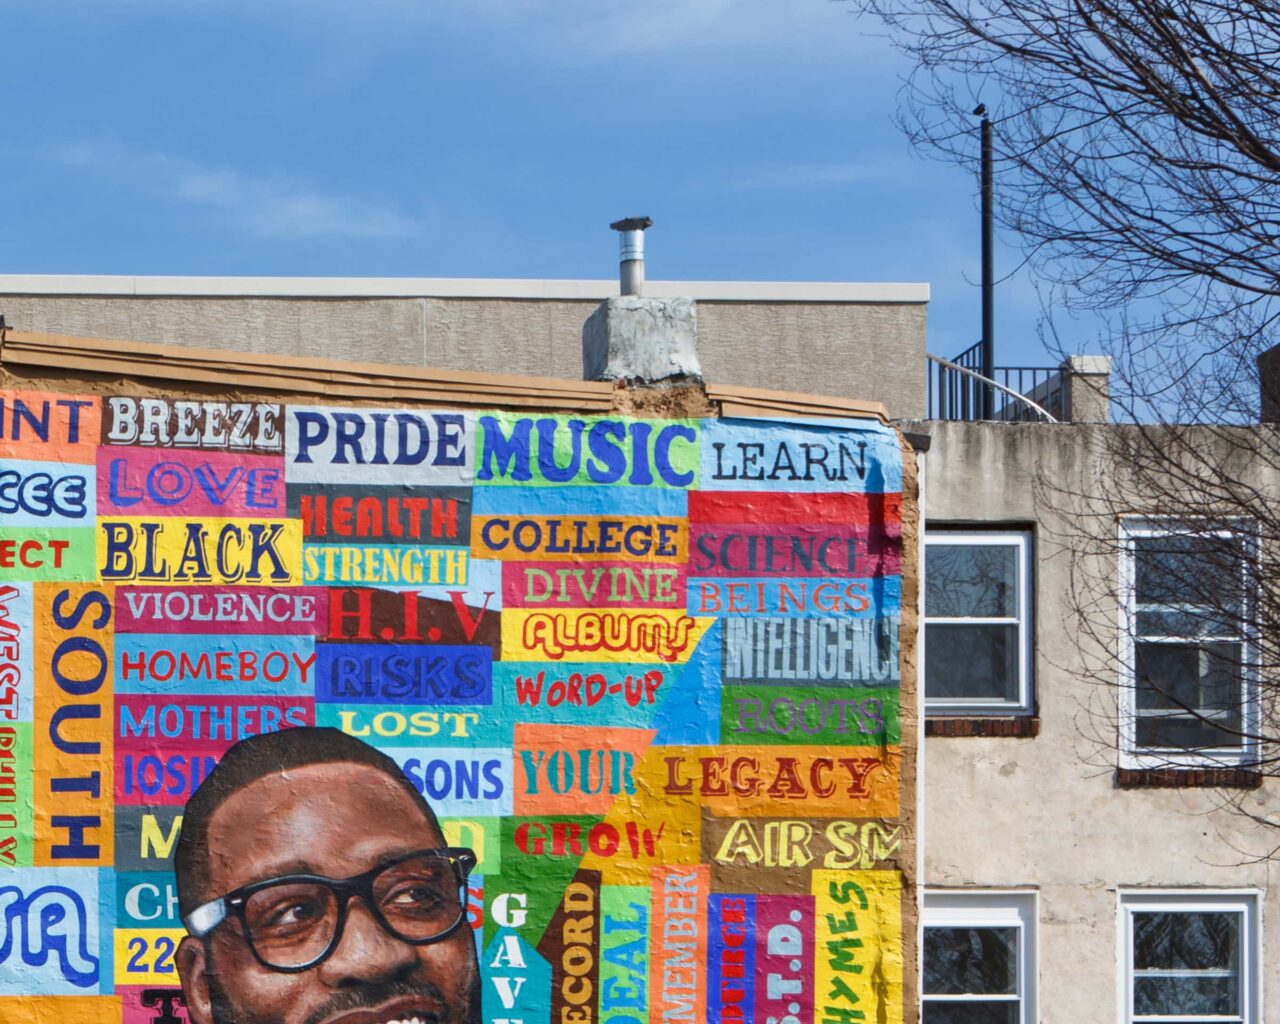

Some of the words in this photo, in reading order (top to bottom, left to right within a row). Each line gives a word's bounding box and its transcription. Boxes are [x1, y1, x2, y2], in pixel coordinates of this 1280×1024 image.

[109, 396, 282, 451] BREEZE
[293, 411, 467, 467] PRIDE
[477, 416, 697, 487] MUSIC
[711, 441, 868, 482] LEARN
[109, 458, 279, 509] LOVE
[300, 494, 458, 539] HEALTH
[481, 518, 678, 557] COLLEGE
[100, 522, 291, 584] BLACK
[302, 547, 468, 586] STRENGTH
[695, 532, 869, 574] SCIENCE
[124, 591, 317, 623] VIOLENCE
[523, 567, 678, 604] DIVINE
[697, 581, 870, 613] BEINGS
[327, 587, 495, 642] H.I.V
[521, 613, 697, 662] ALBUMS
[725, 616, 901, 681] INTELLIGENCE
[121, 650, 318, 684] HOMEBOY
[330, 653, 488, 699] RISKS
[49, 588, 111, 859] SOUTH
[120, 704, 308, 741] MOTHERS
[338, 711, 480, 738] LOST
[733, 696, 885, 736] ROOTS
[520, 749, 637, 796] YOUR
[663, 755, 886, 800] LEGACY
[715, 819, 815, 868] AIR
